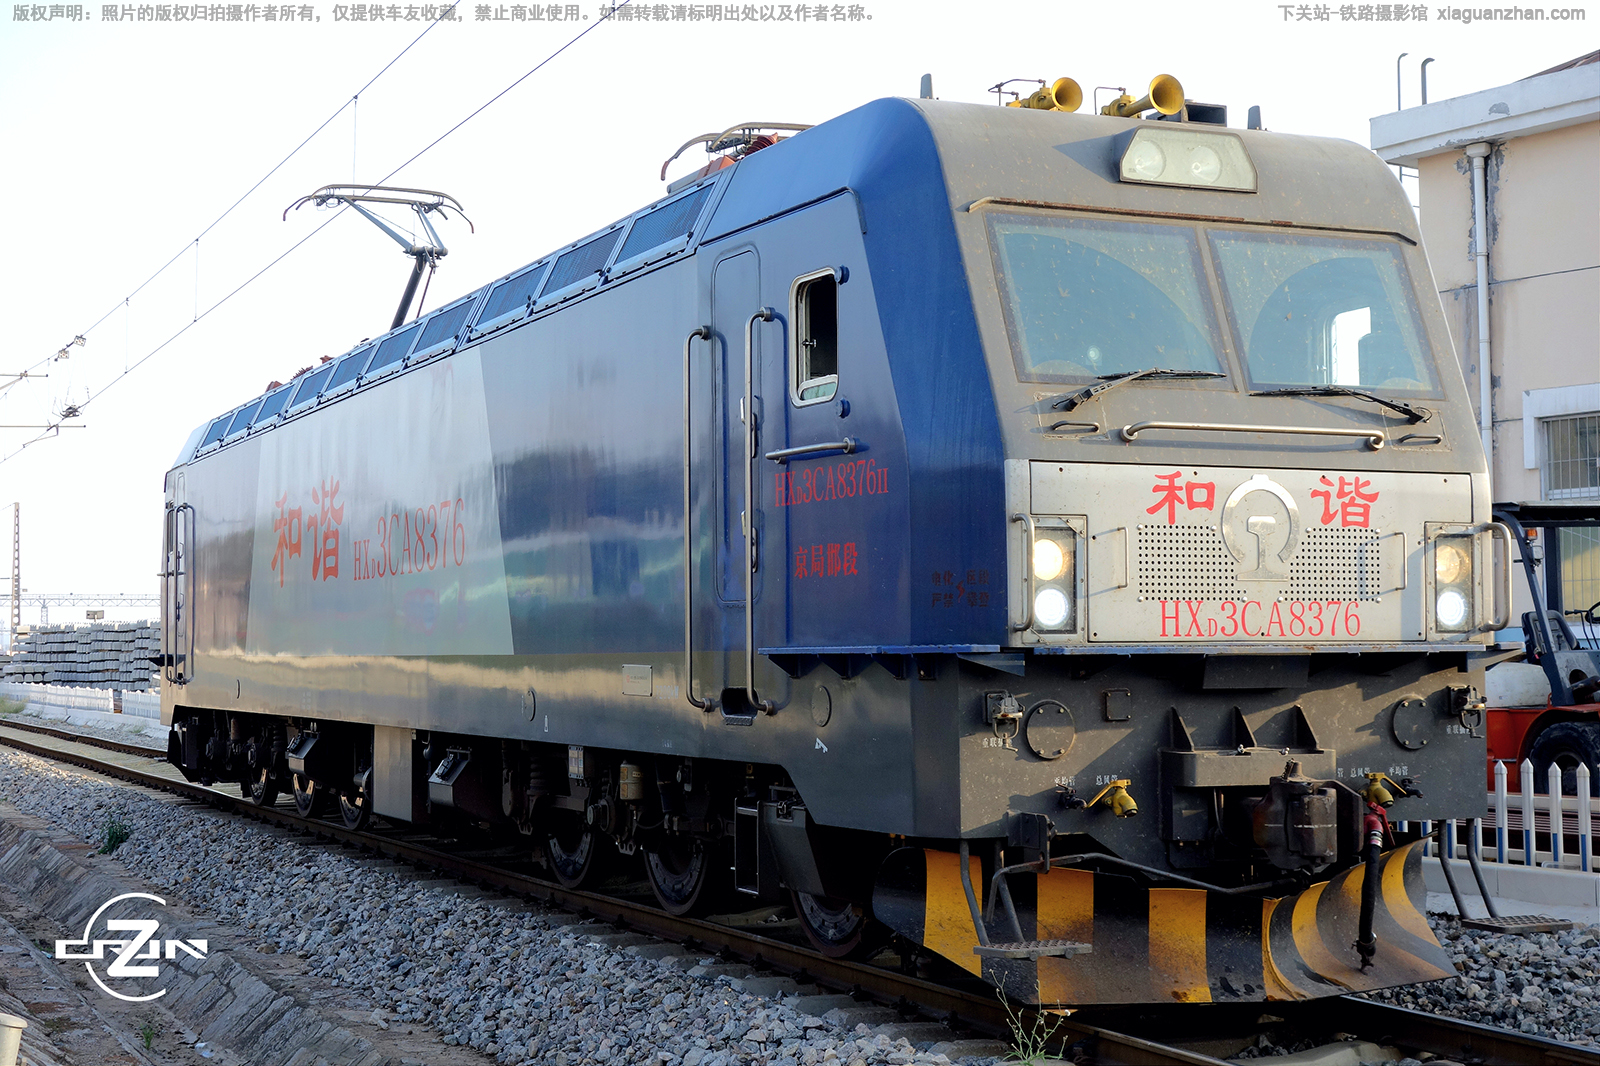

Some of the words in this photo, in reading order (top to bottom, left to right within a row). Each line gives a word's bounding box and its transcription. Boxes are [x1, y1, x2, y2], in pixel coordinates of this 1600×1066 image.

[271, 475, 345, 588] 和谐
[353, 497, 465, 581] HXD3CA8376
[1159, 600, 1361, 637] HXD3CA8376
